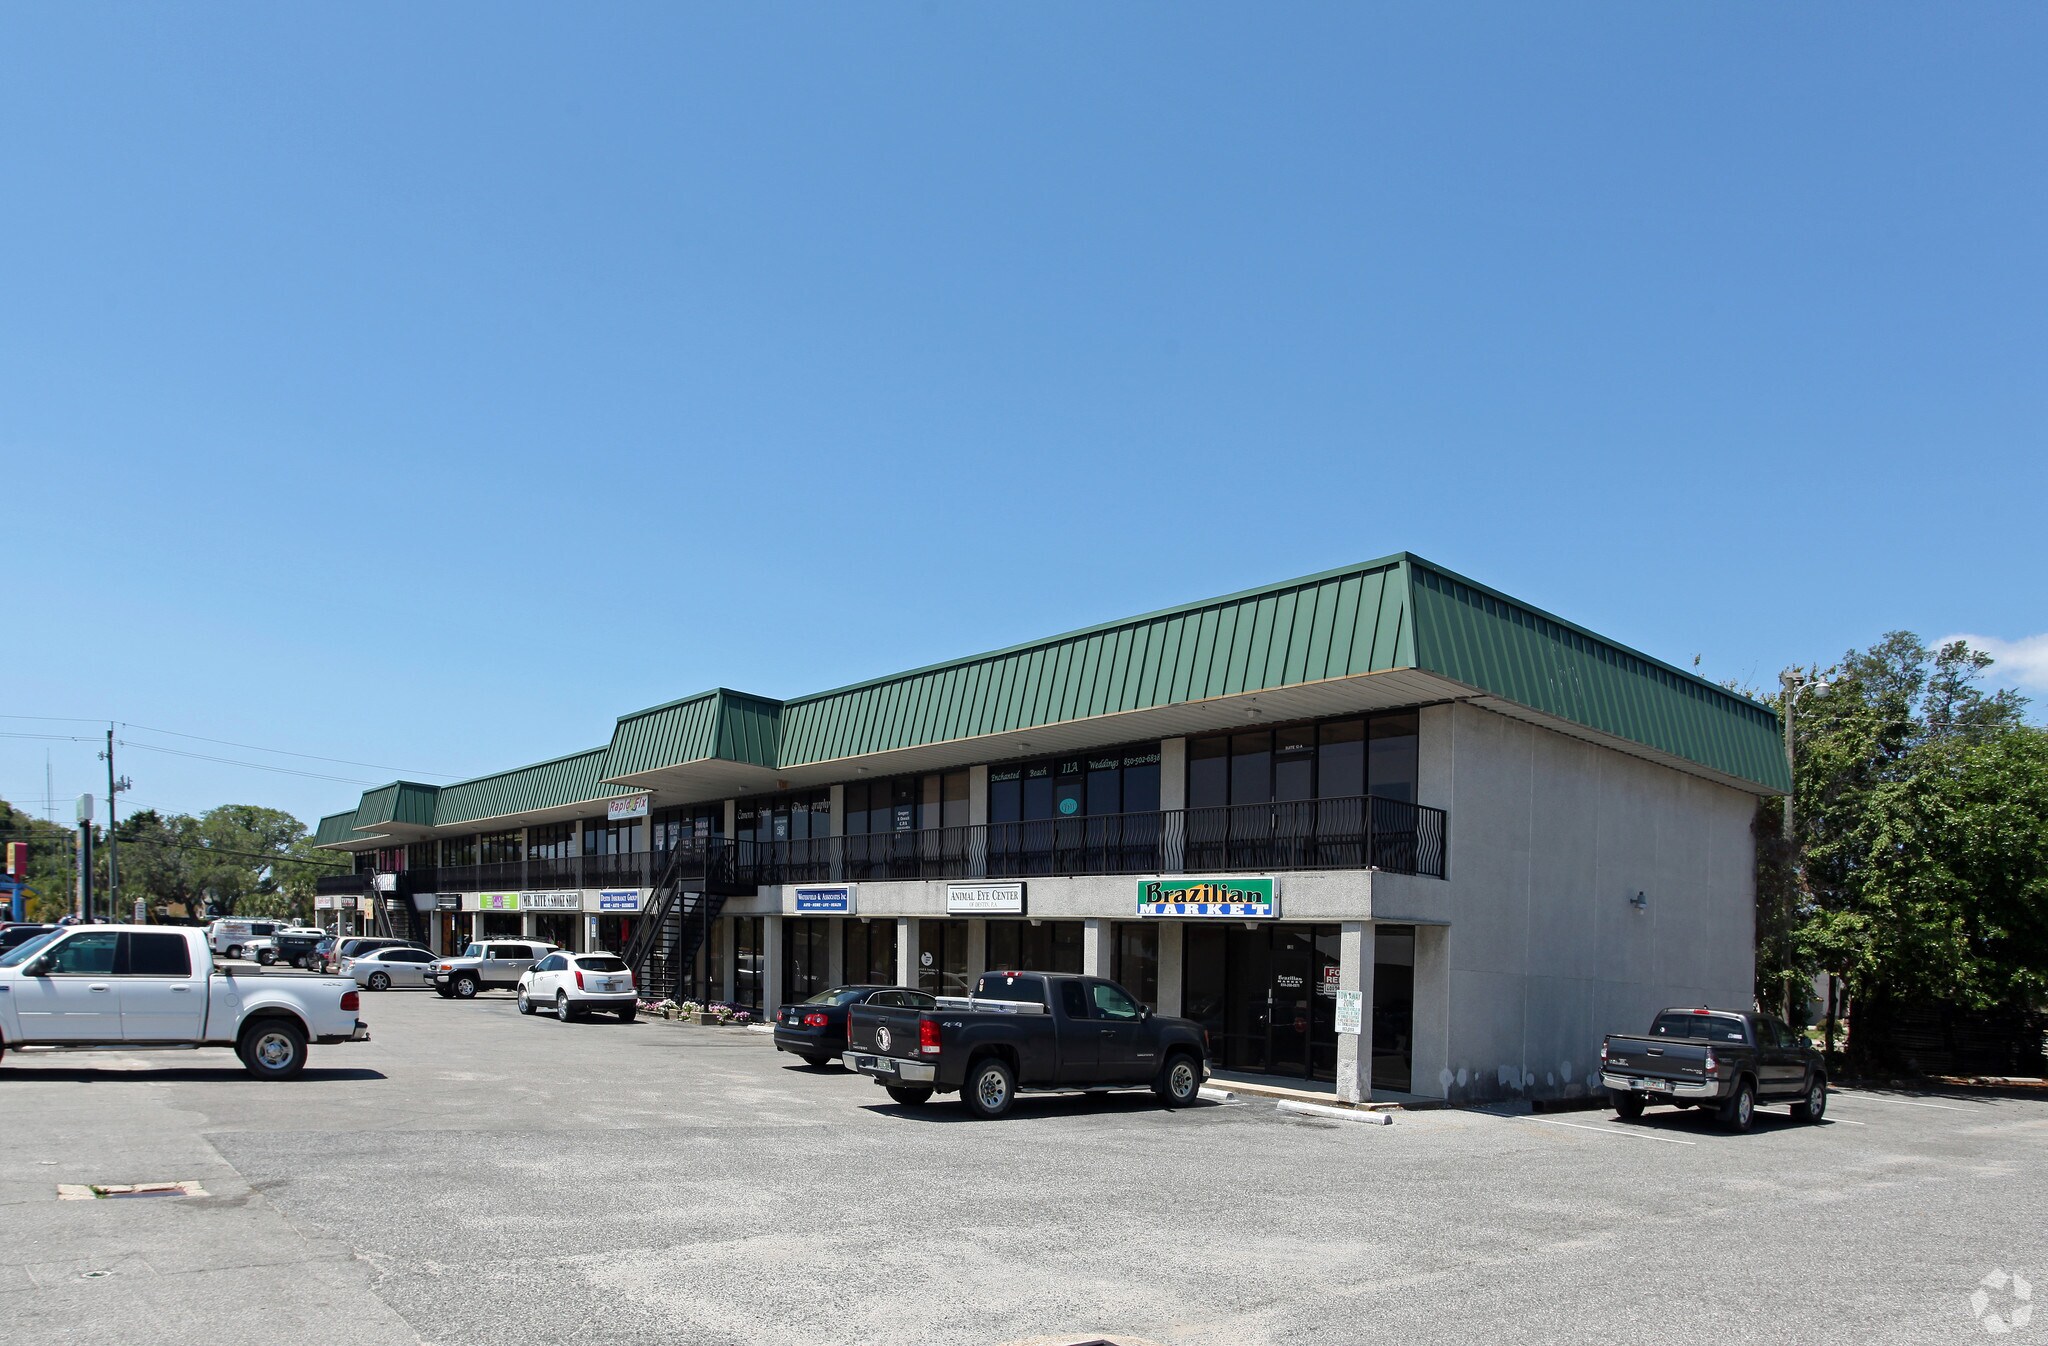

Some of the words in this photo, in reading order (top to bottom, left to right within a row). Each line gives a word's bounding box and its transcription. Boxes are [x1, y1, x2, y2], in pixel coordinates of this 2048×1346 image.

[991, 770, 1020, 782] Enchanted
[1029, 766, 1047, 777] Beach
[1062, 761, 1079, 774] 11A
[1088, 759, 1119, 770] Weddings
[610, 799, 631, 813] Rapid
[635, 797, 647, 809] Fix
[950, 891, 975, 901] ANIMAL
[977, 890, 990, 901] EYE
[992, 889, 1019, 901] CENTER
[1145, 881, 1264, 904] Brazilian
[566, 894, 578, 907] SHOP
[1139, 903, 1269, 915] MARKET
[1328, 968, 1340, 977] FO
[1326, 976, 1340, 984] RE
